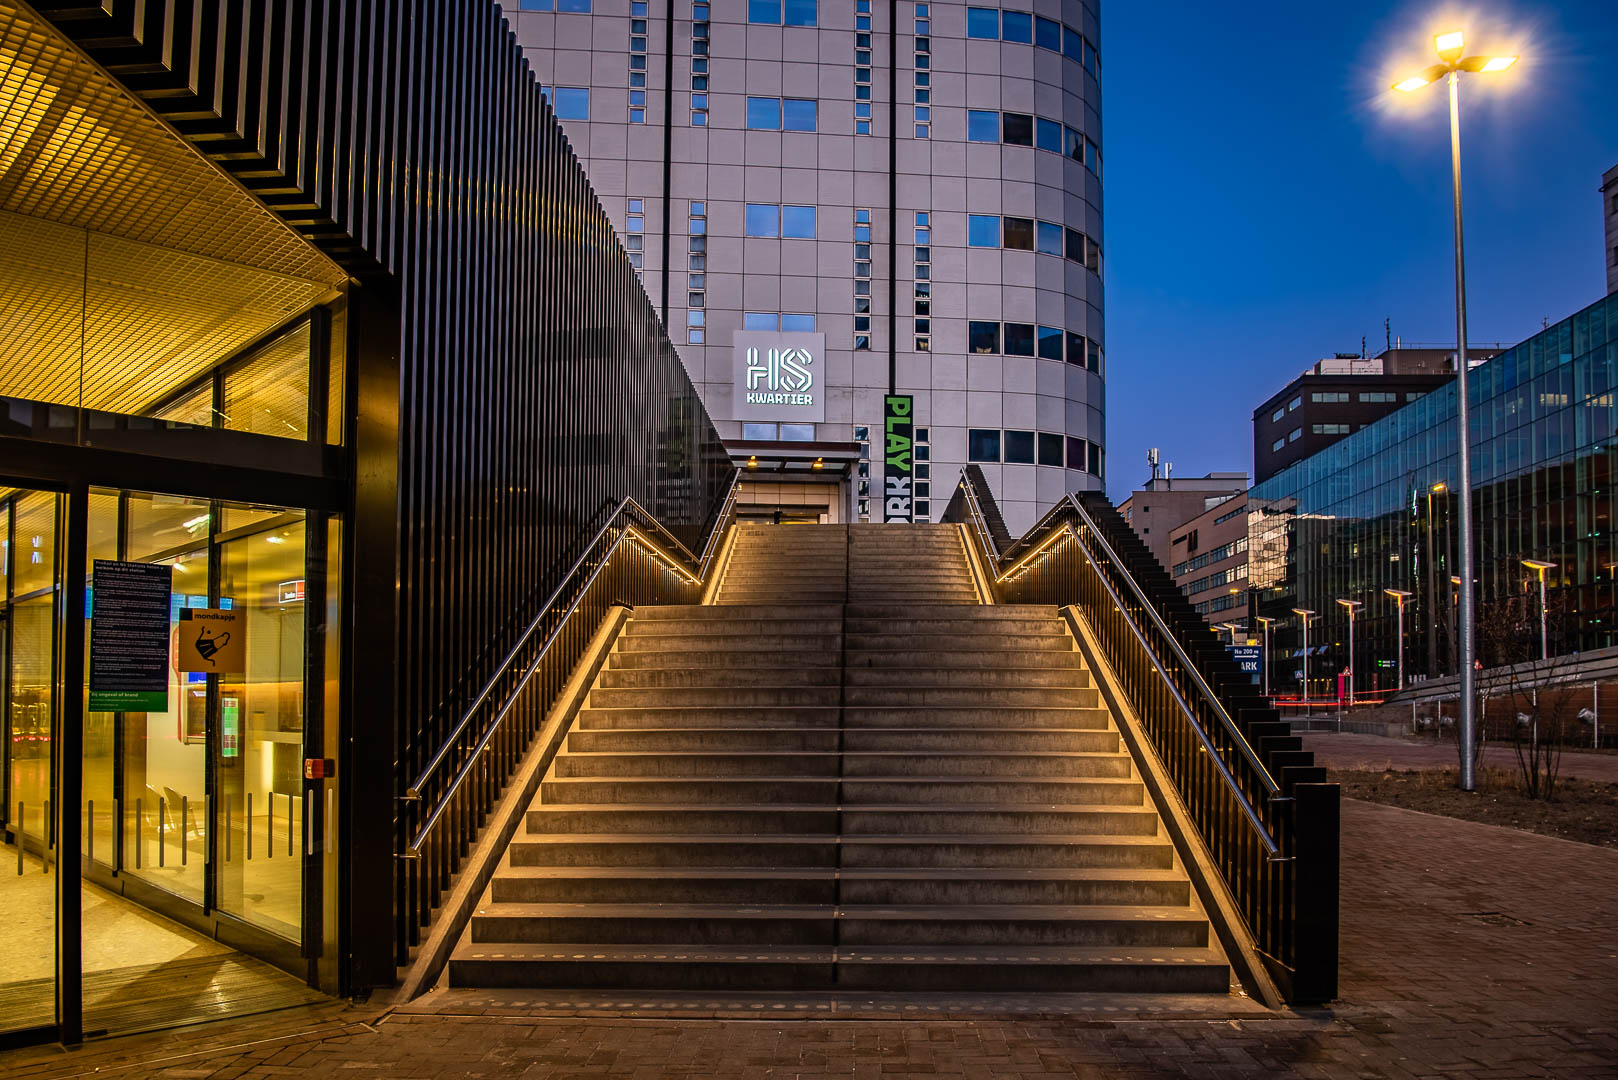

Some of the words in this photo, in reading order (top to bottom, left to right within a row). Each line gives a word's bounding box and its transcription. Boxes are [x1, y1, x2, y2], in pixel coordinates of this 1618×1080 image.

[746, 346, 813, 392] HS
[746, 393, 813, 406] KWARTIER
[886, 397, 911, 472] PLAY
[194, 613, 236, 622] mondkapje
[1241, 661, 1257, 671] ARK
